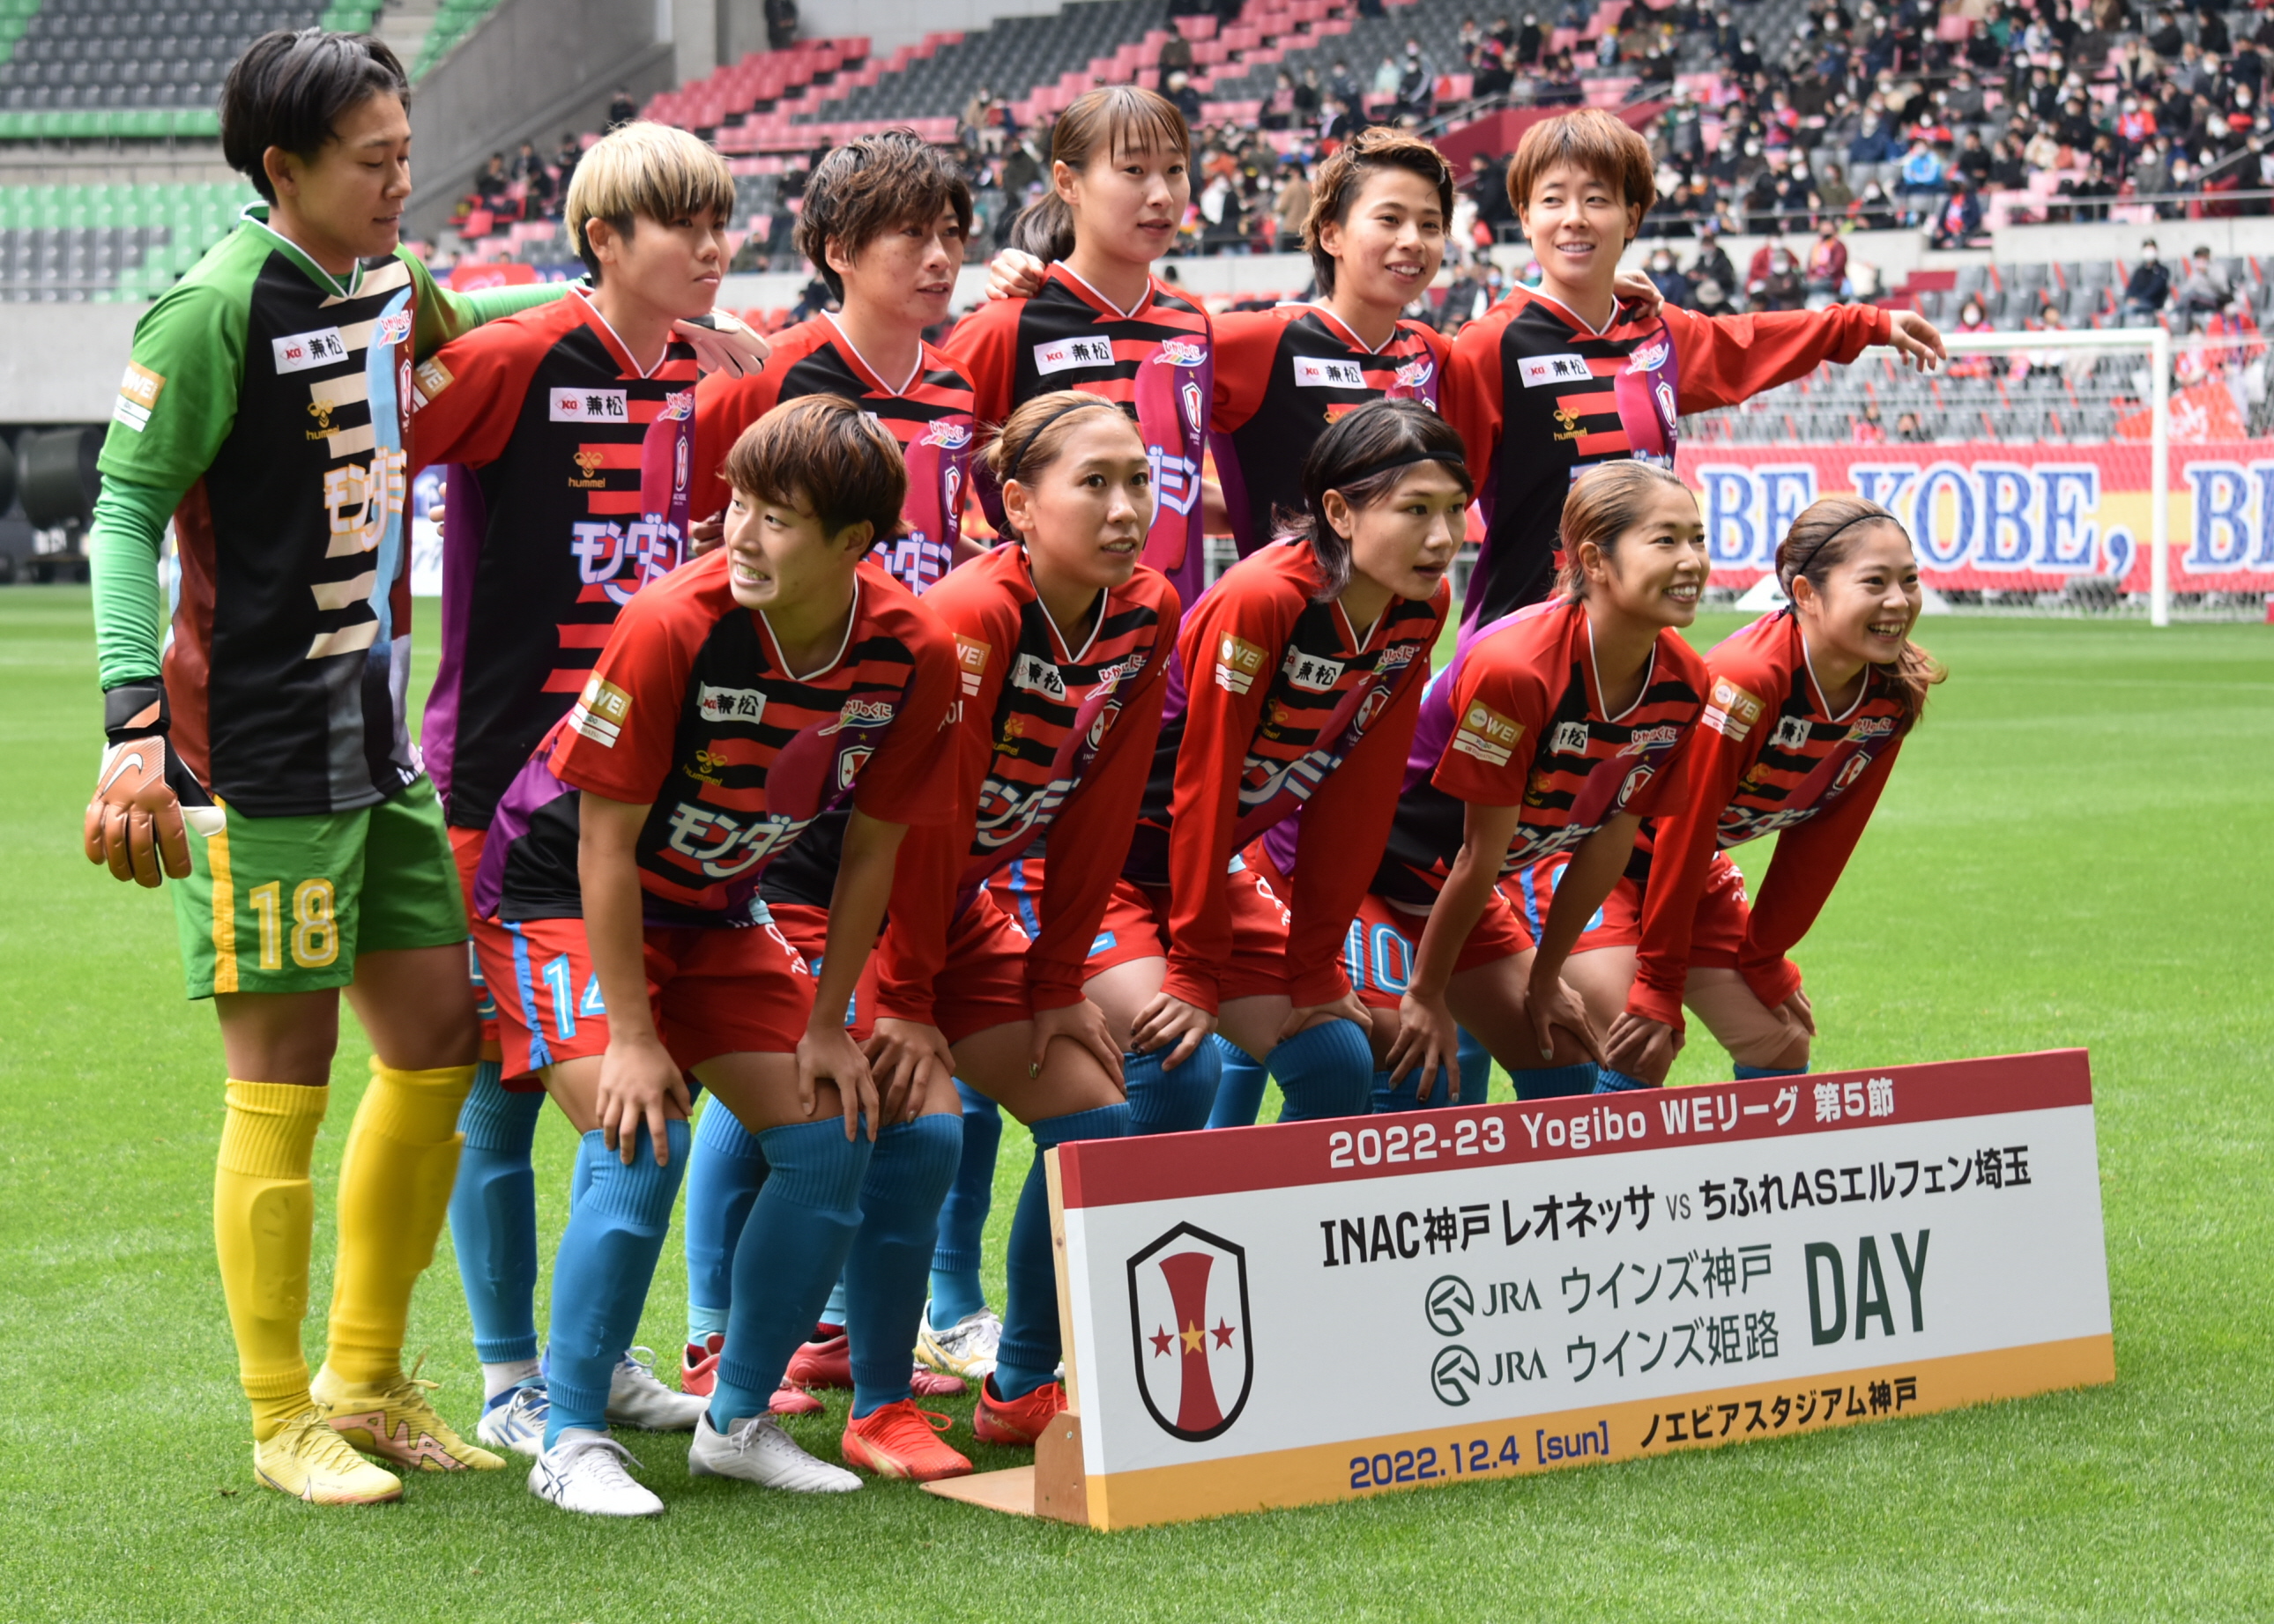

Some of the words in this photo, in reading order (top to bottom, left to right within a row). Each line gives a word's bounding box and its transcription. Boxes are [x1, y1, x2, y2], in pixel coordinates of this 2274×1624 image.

[308, 335, 344, 360] 兼松
[1071, 342, 1110, 361] 兼松
[1325, 365, 1361, 383] 兼松
[1551, 360, 1587, 376] 兼松
[586, 396, 624, 416] 兼松
[306, 424, 340, 441] hummel
[1554, 427, 1587, 441] hummel
[568, 478, 606, 488] hummel
[1296, 661, 1337, 686] 兼松
[717, 693, 759, 716] 兼松
[1486, 716, 1514, 742] WE
[682, 763, 724, 786] hummel
[249, 878, 339, 970] 18
[1344, 918, 1414, 996] 10
[1329, 1116, 1505, 1168] 2022-23
[1520, 1106, 1646, 1149] Yogibo
[1660, 1086, 1799, 1135] WEリーグ
[1813, 1077, 1894, 1123] 第5節
[1699, 1145, 2032, 1221] ちふれASエルフェン埼玉
[1482, 1279, 1542, 1317] JRA
[1561, 1243, 1772, 1314] ウインズ神戸
[1803, 1228, 1930, 1346] DAY
[1488, 1346, 1549, 1385] JRA
[1566, 1309, 1780, 1383] ウインズ姫路
[1349, 1435, 1520, 1490] 2022.12.4
[1536, 1420, 1609, 1465] [sun]
[1640, 1376, 1918, 1449] ノエビアスタジアム神戸
